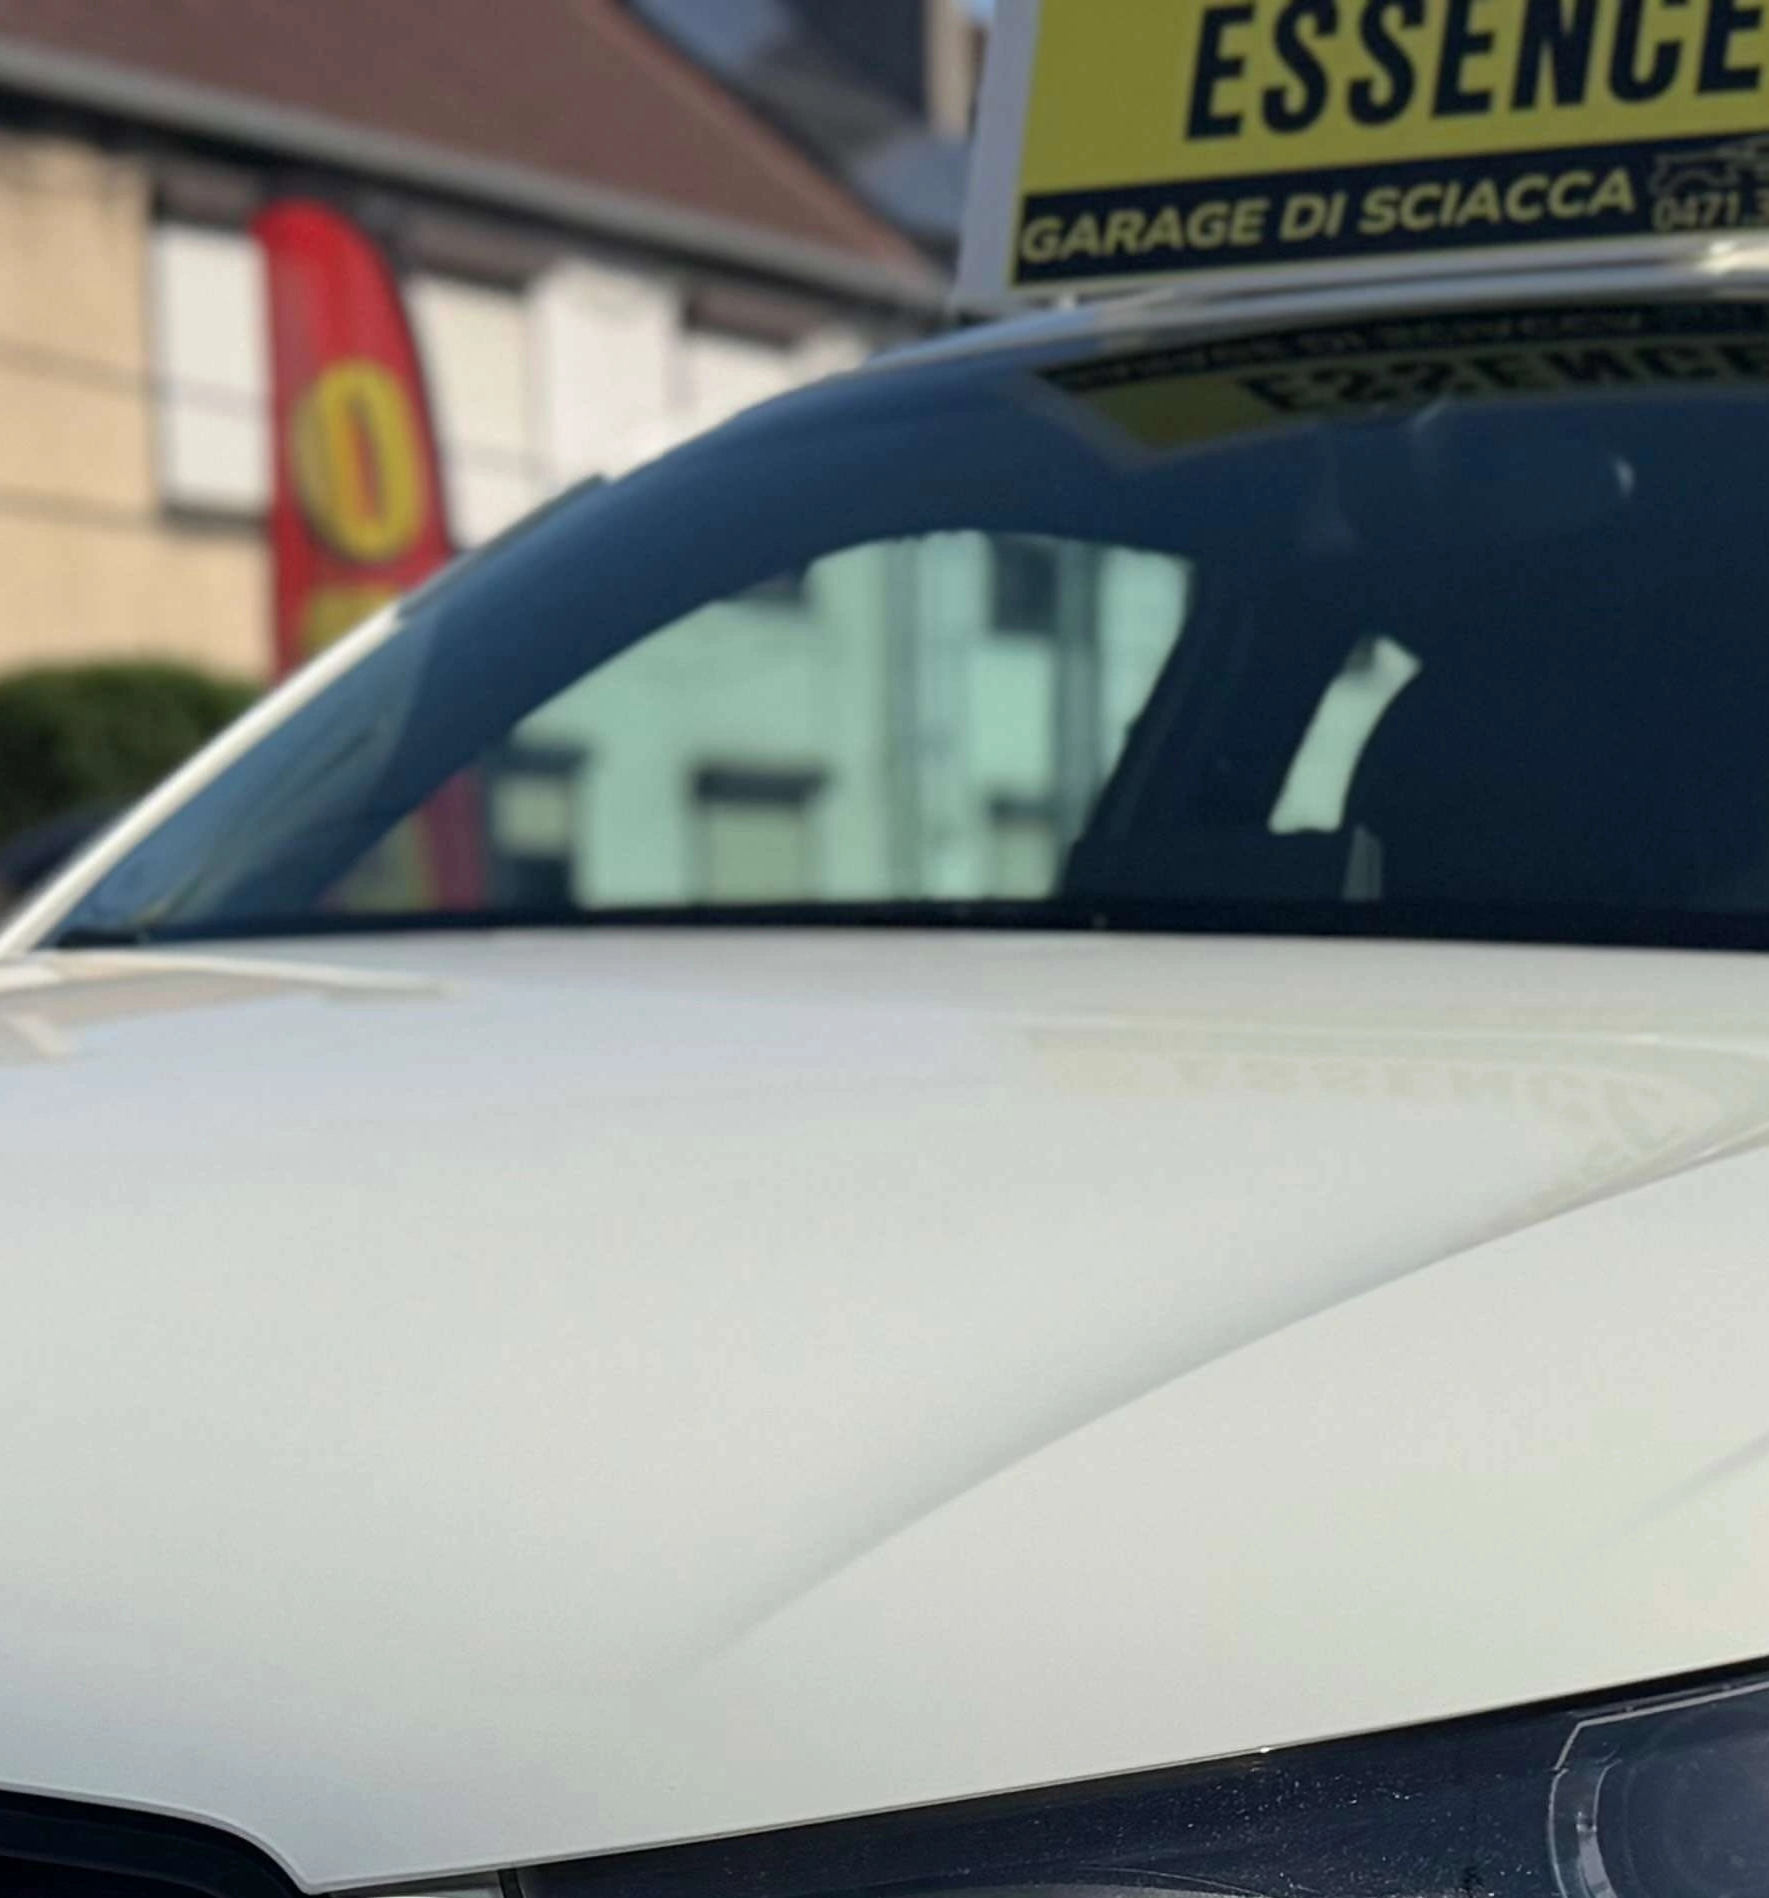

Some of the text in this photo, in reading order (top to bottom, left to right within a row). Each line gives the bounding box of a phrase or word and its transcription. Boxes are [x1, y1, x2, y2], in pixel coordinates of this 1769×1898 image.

[1184, 0, 1765, 140] ESSENCE
[1021, 168, 1635, 262] GARAGE DI SCIACCA
